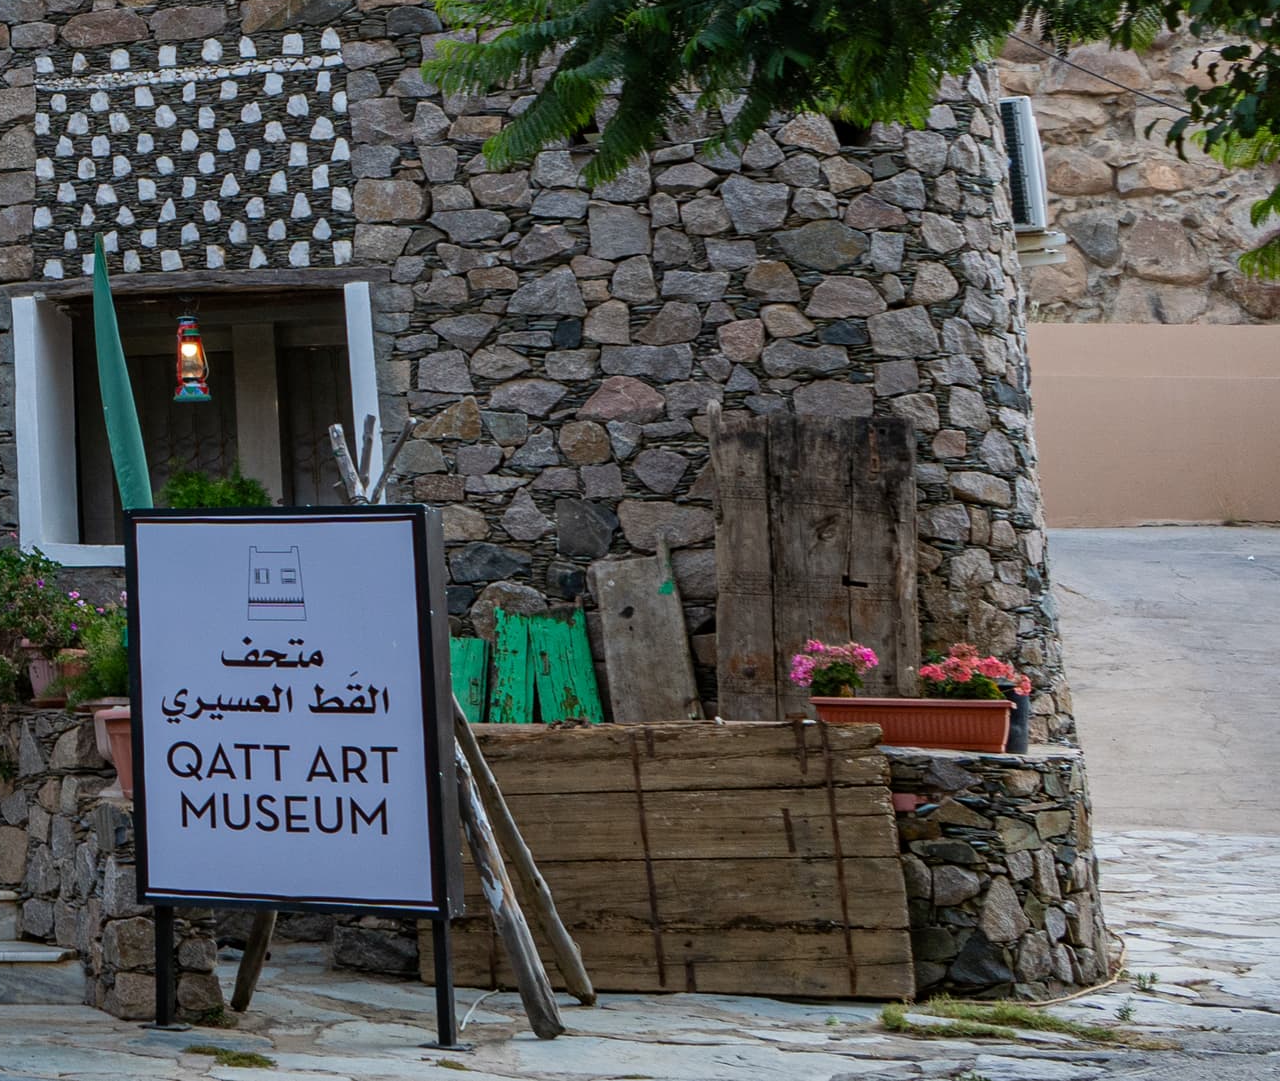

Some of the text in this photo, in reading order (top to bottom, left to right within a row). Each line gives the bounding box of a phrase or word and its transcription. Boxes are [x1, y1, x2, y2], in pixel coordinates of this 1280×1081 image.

[221, 636, 324, 668] متحف
[160, 684, 293, 724] العسيري
[166, 741, 398, 784] QATT ART
[180, 791, 388, 835] MUSEUM
